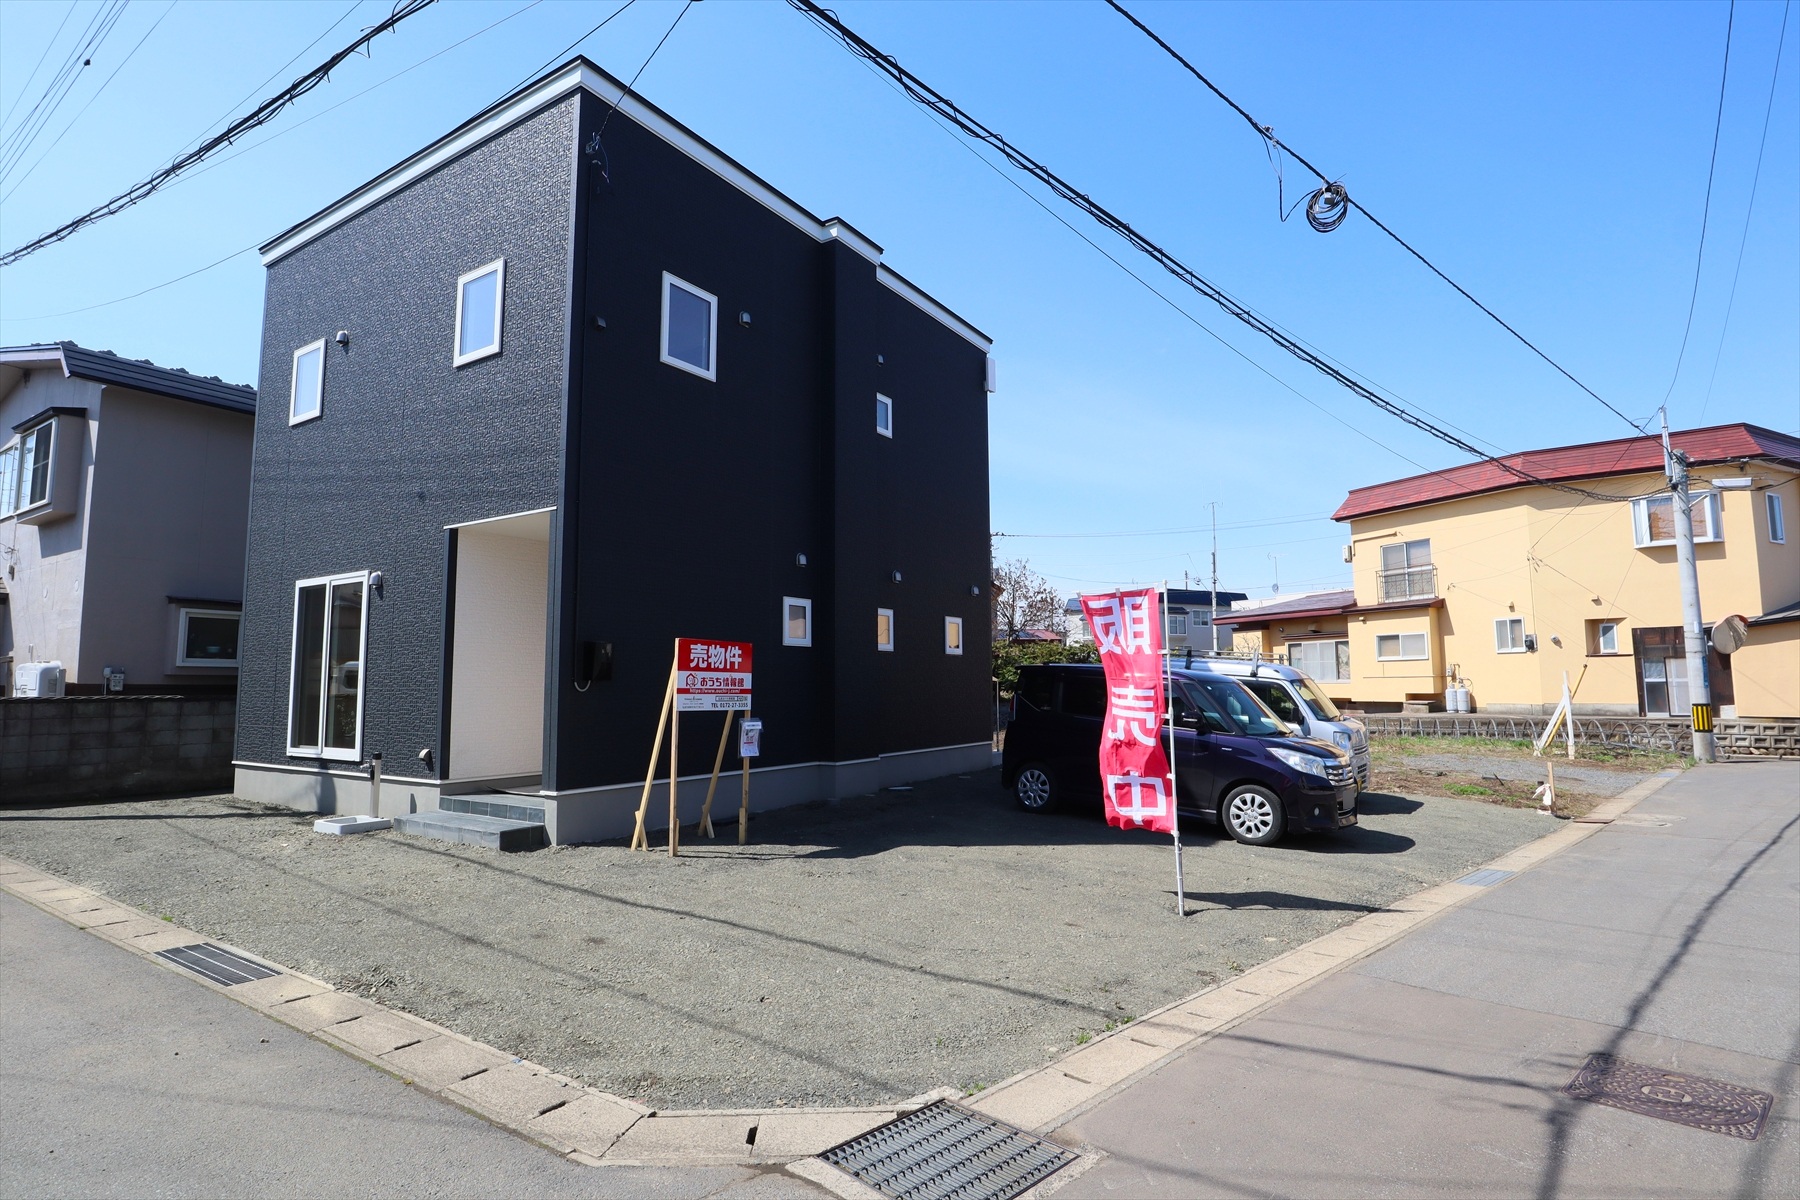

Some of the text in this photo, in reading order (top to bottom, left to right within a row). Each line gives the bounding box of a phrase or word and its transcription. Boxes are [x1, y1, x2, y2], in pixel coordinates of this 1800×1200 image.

[690, 644, 742, 669] 売物件
[700, 677, 744, 687] おうち情報館
